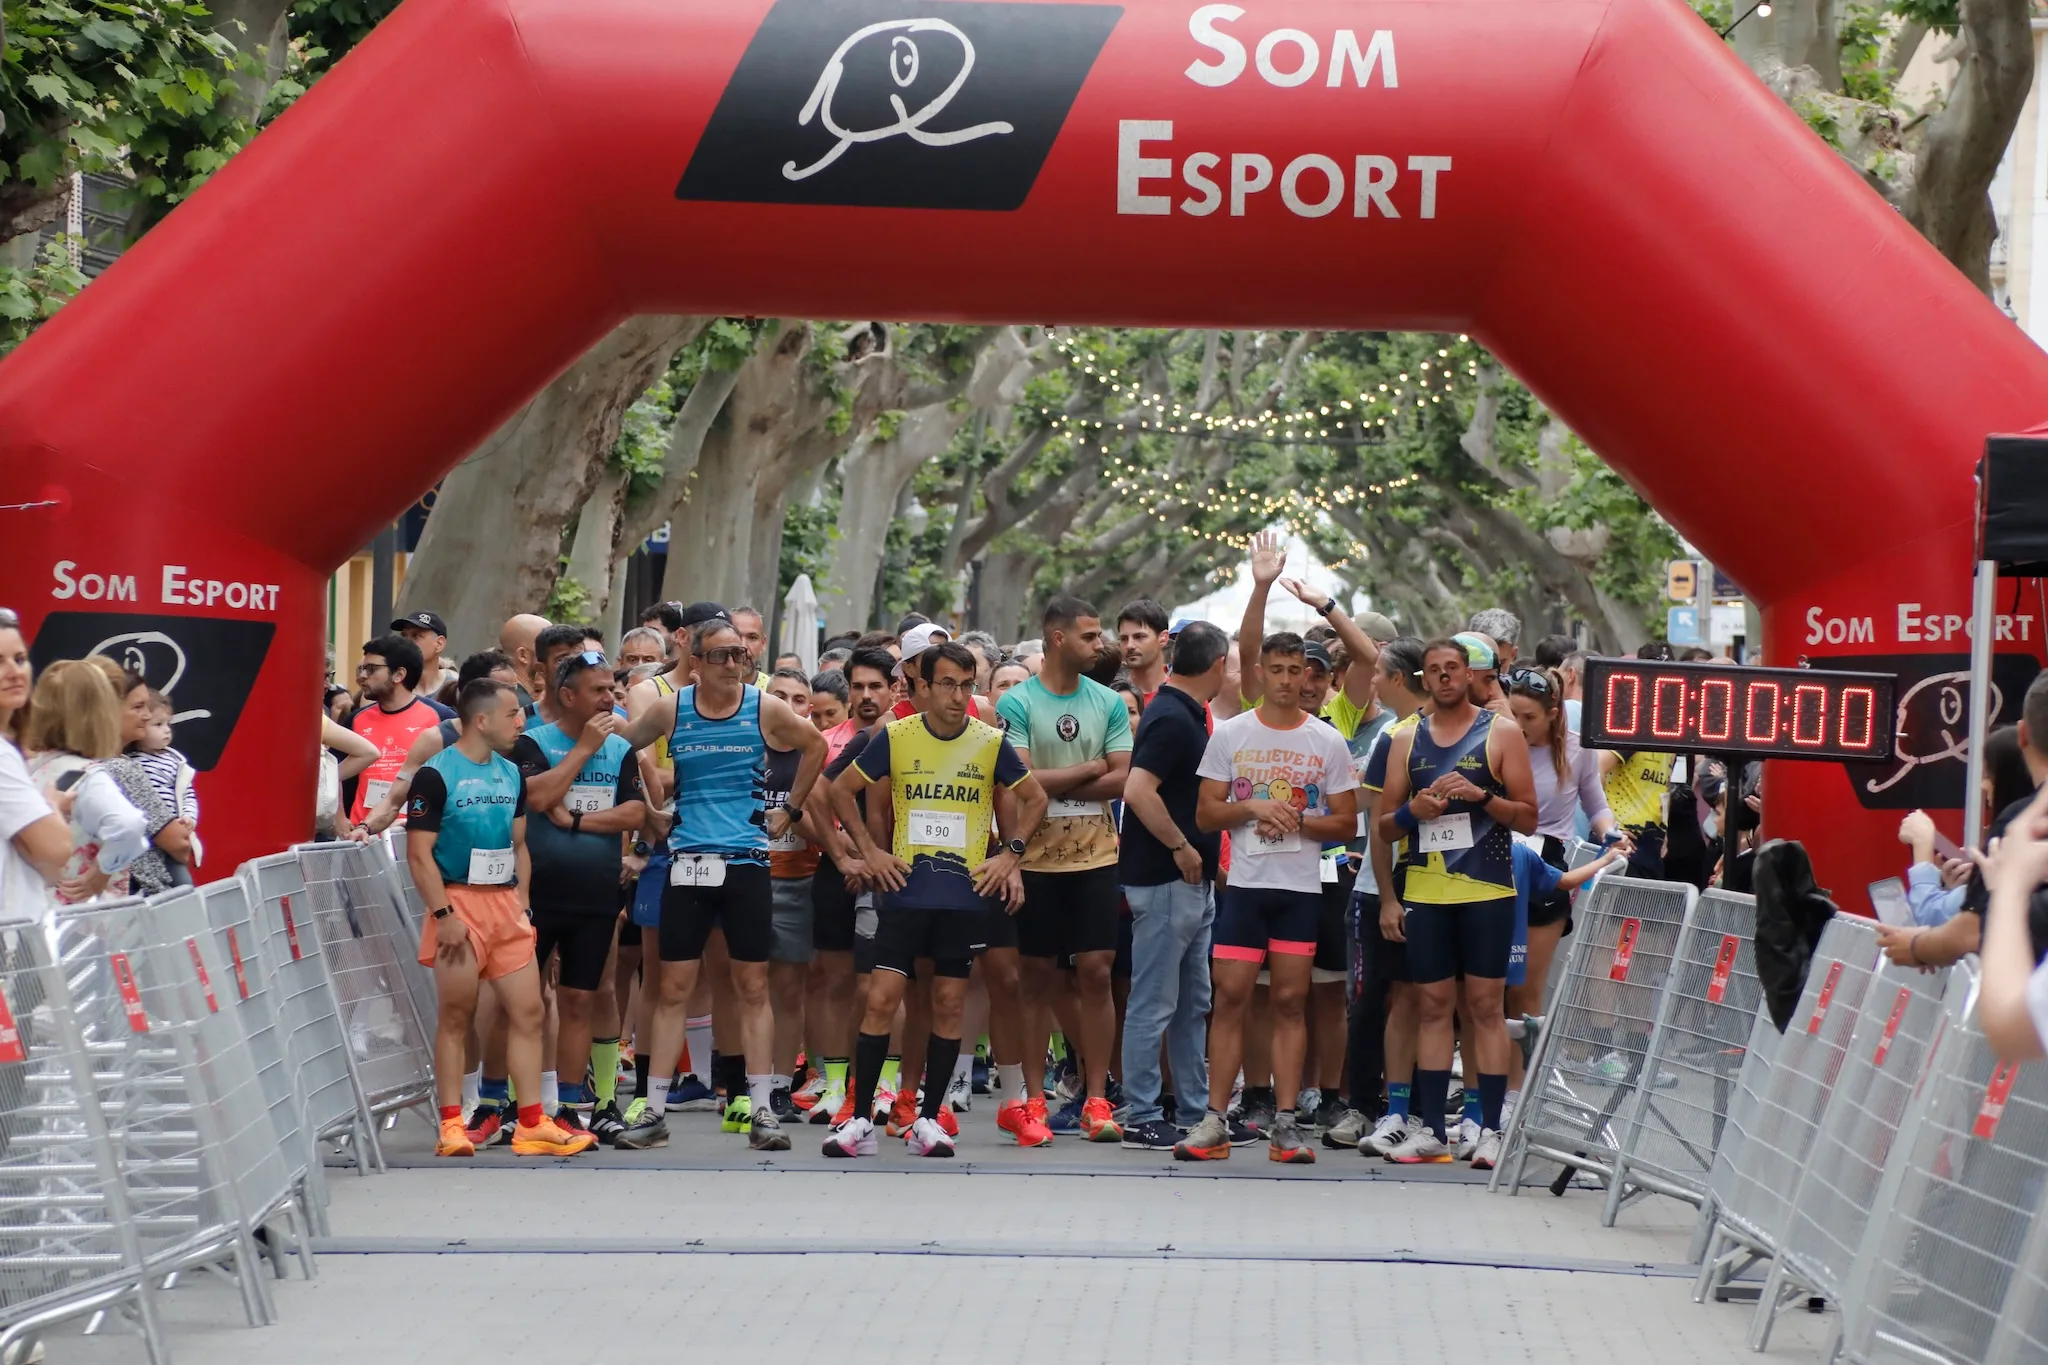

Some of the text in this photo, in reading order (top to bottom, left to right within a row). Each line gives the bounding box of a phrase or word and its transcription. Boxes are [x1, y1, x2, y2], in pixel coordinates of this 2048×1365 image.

[1184, 2, 1400, 89] SOM
[1117, 119, 1453, 220] ESPORT
[51, 559, 281, 612] SOM ESPORT
[1805, 606, 1875, 646] SOM
[1233, 748, 1324, 768] BELIEVE IN
[1236, 765, 1326, 785] YOURSELF
[576, 800, 599, 811] B 63
[784, 833, 796, 843] 16
[925, 825, 950, 837] B 90
[1430, 830, 1454, 842] A 42
[487, 863, 505, 875] S 17
[686, 866, 710, 877] B 44
